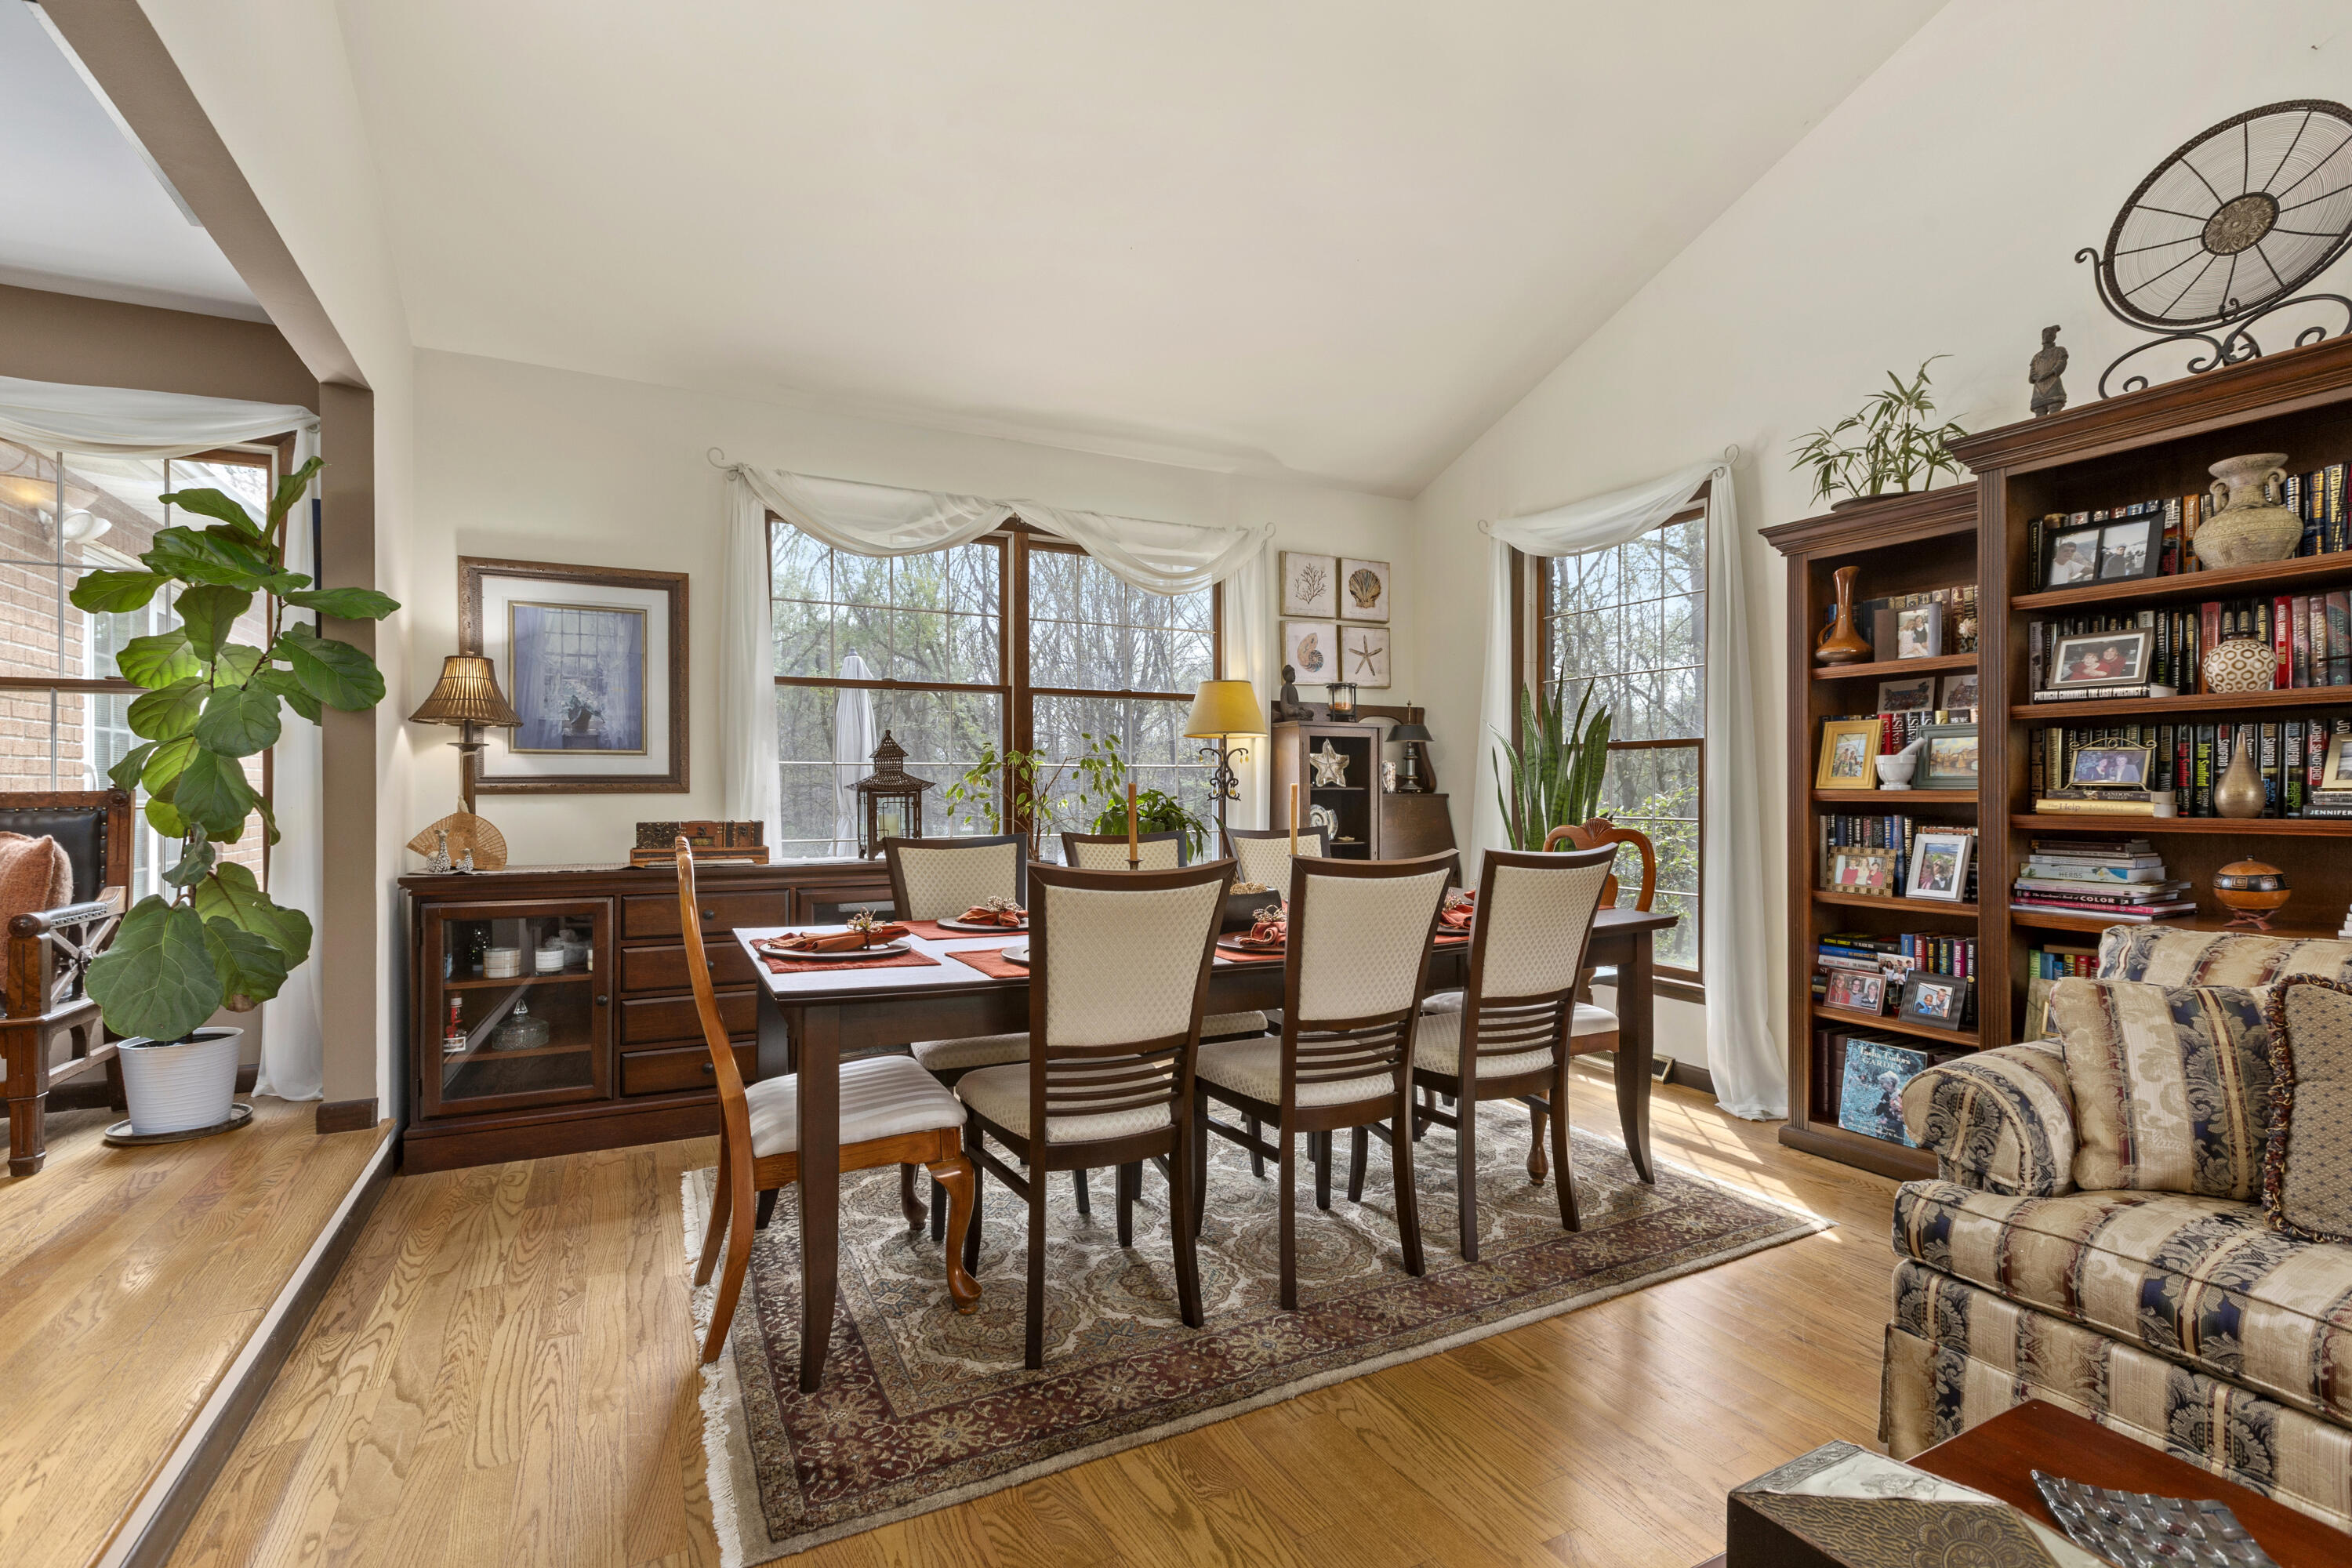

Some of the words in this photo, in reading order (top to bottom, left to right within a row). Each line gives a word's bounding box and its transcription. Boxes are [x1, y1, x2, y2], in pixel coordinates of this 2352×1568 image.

[2288, 477, 2299, 495] CLIVE
[2313, 472, 2324, 491] CLIVE
[2330, 467, 2342, 491] CLIVE
[2313, 492, 2324, 518] CUSSLER
[2034, 691, 2058, 701] PATRICIA
[2059, 689, 2087, 699] CORNWELL
[2089, 688, 2099, 698] THE
[2100, 688, 2113, 698] LAST
[2114, 687, 2142, 696] PRECINCT
[1893, 720, 1904, 745] Silva
[2219, 725, 2230, 739] JOHN
[2263, 723, 2276, 737] JOHN
[2288, 723, 2301, 736] JOHN
[2312, 723, 2322, 742] JOHN
[2178, 742, 2190, 757] John
[2197, 743, 2211, 758] John
[2217, 739, 2230, 767] SANDFORD
[2263, 738, 2276, 766] SANDFORD
[2288, 737, 2301, 765] SANDFORD
[2312, 744, 2321, 780] SANDFORD
[2178, 759, 2190, 786] Sandford
[2197, 760, 2210, 786] Sandford
[2287, 781, 2296, 808] PREY
[2059, 803, 2081, 812] Help
[2063, 962, 2074, 977] JAN
[2077, 962, 2087, 977] JAN
[1858, 1046, 1882, 1060] Tasha
[1882, 1049, 1911, 1065] Tudor's
[1862, 1057, 1904, 1071] GARDEN
